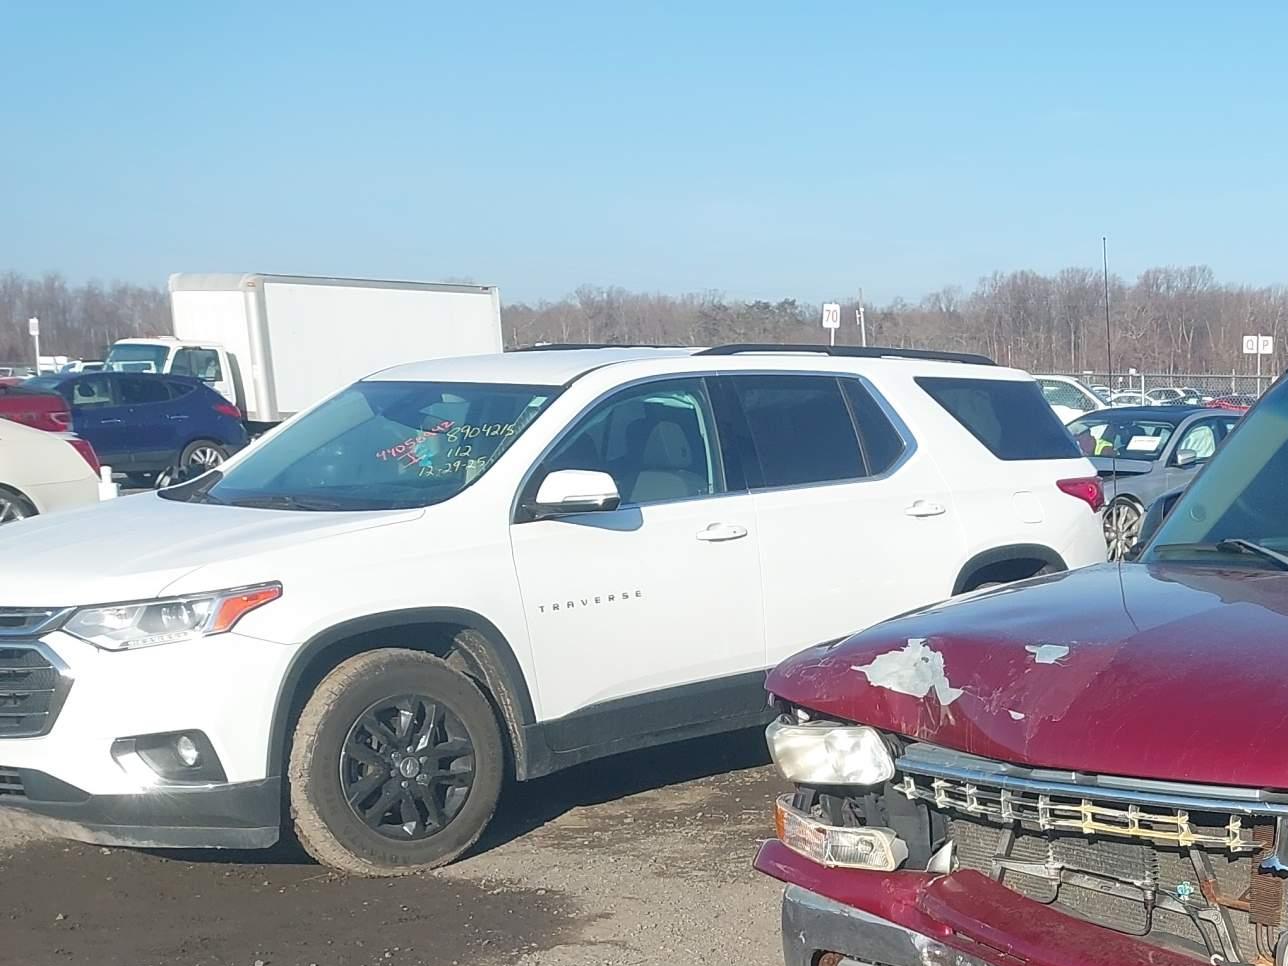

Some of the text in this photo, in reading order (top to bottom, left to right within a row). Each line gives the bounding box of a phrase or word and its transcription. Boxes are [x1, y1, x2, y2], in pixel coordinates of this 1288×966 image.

[825, 309, 838, 323] 70
[1262, 339, 1270, 351] P
[446, 445, 472, 459] 112
[538, 590, 643, 614] TRAVERSE
